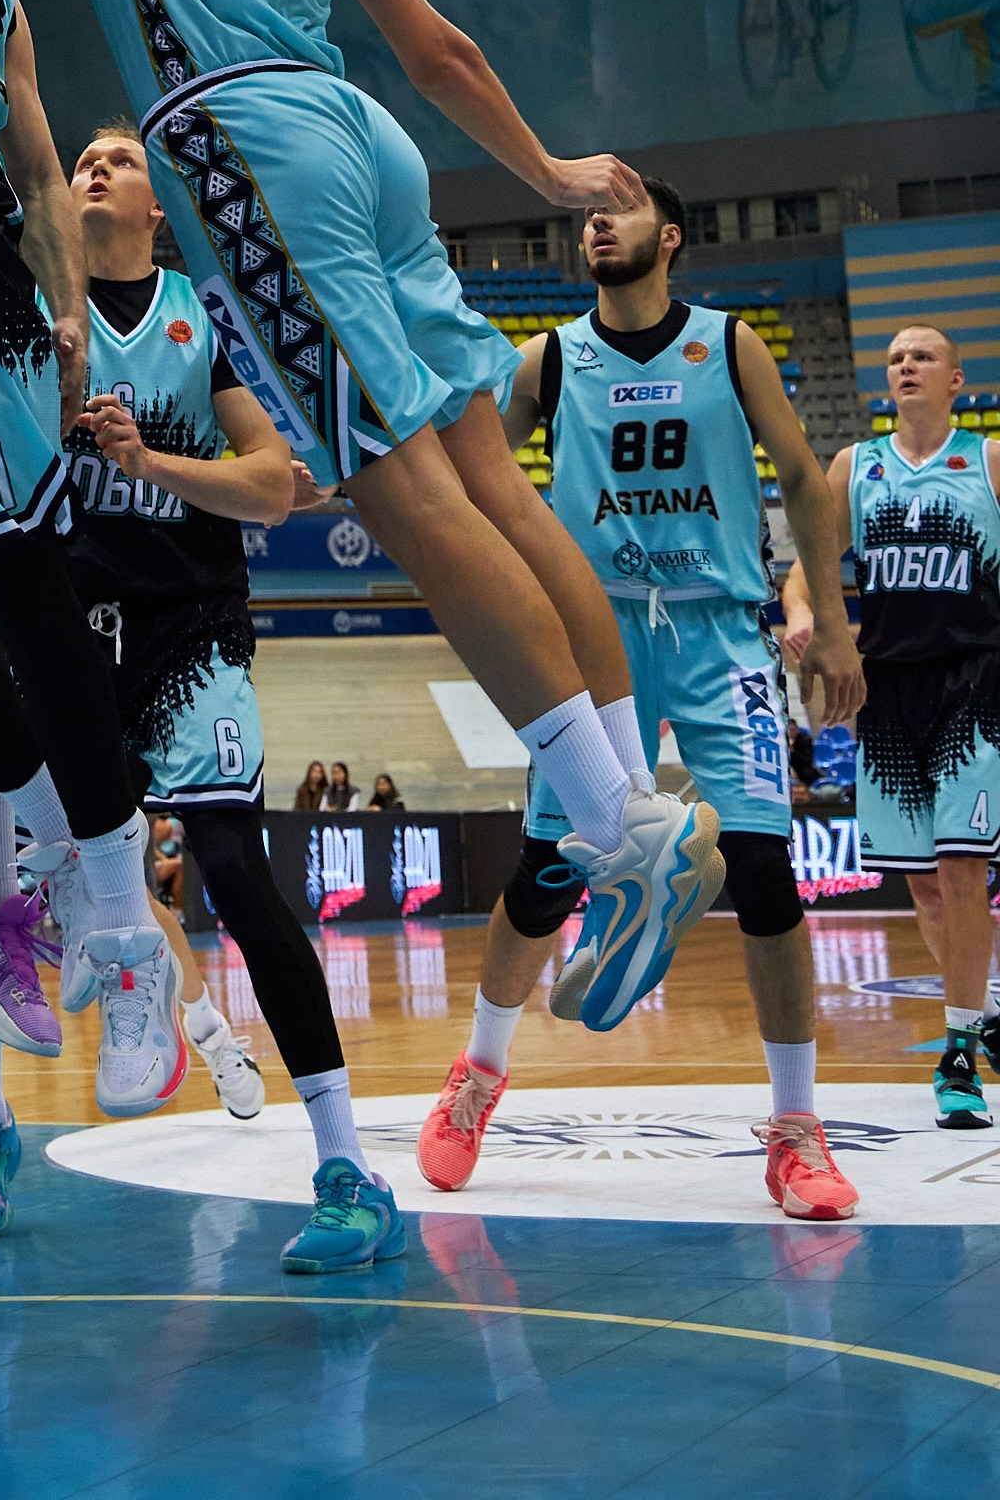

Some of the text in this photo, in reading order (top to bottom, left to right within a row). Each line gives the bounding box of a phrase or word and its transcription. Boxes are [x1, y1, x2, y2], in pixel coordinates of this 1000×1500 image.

[613, 385, 677, 403] 1XBET
[611, 418, 689, 473] 88
[593, 484, 720, 526] ASTANA
[903, 495, 922, 533] 4
[863, 544, 971, 592] ТОБОЛ
[213, 717, 245, 778] 6
[968, 789, 990, 836] 4
